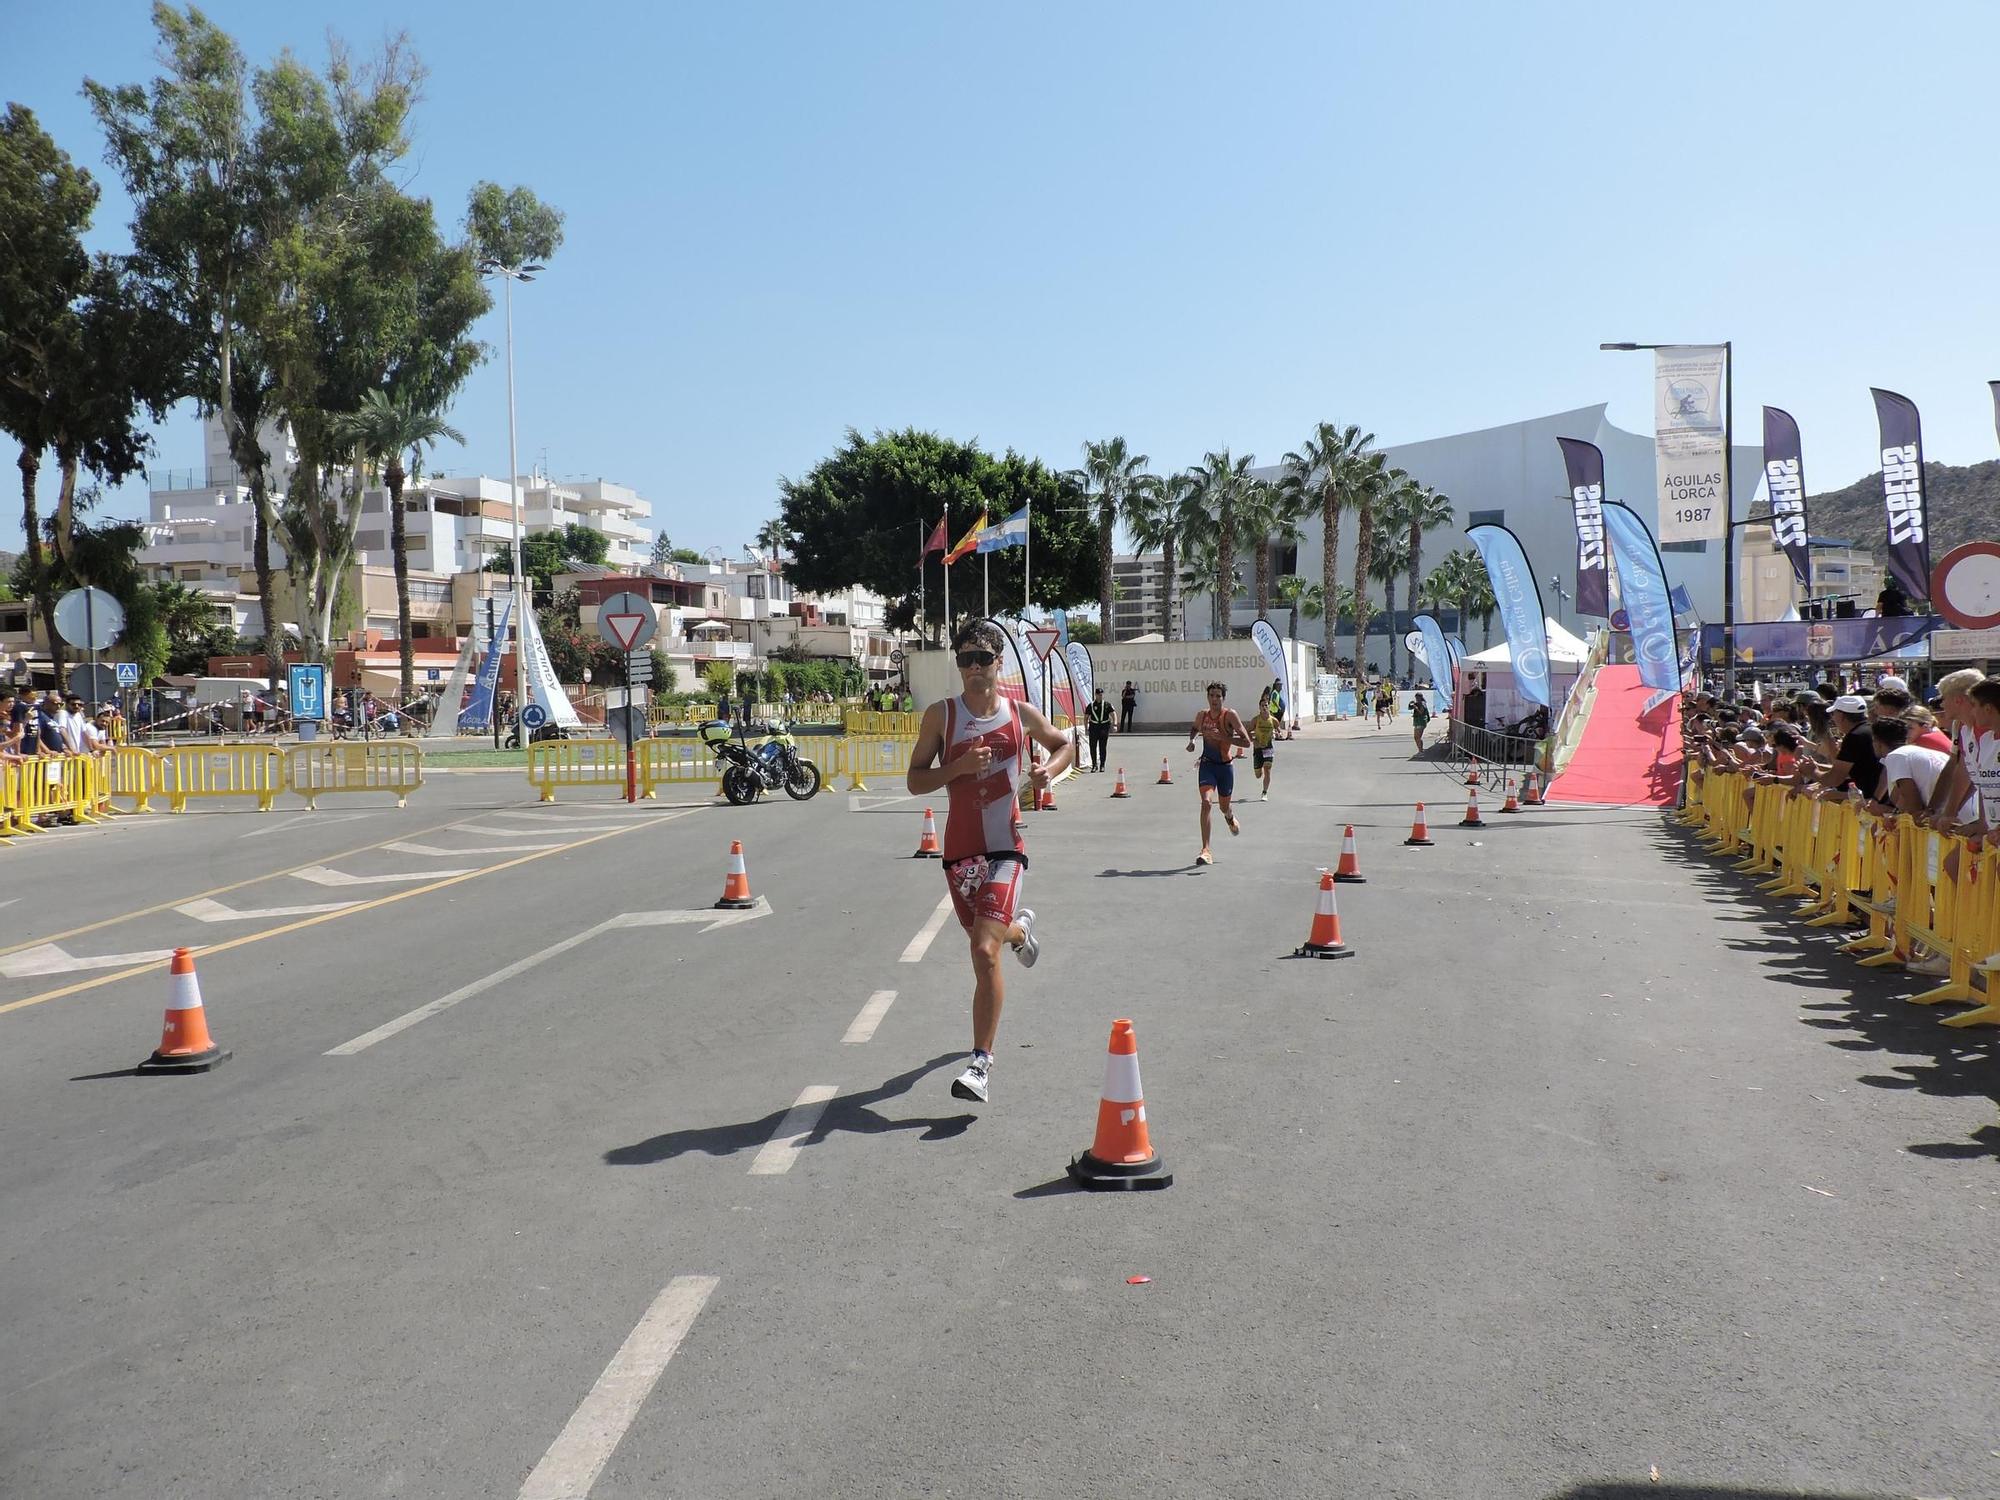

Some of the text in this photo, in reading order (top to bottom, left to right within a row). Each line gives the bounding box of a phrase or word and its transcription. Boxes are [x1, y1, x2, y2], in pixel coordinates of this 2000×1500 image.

[1664, 473, 1721, 487] ÁGUILAS
[1671, 487, 1716, 500] LORCA
[1675, 508, 1711, 523] 1987
[1111, 660, 1119, 671] Y
[1122, 658, 1171, 671] PALACIO
[1175, 657, 1189, 670] DE
[1193, 656, 1265, 669] CONGRESOS
[1145, 679, 1176, 692] DOÑA
[1181, 680, 1214, 692] ELEN
